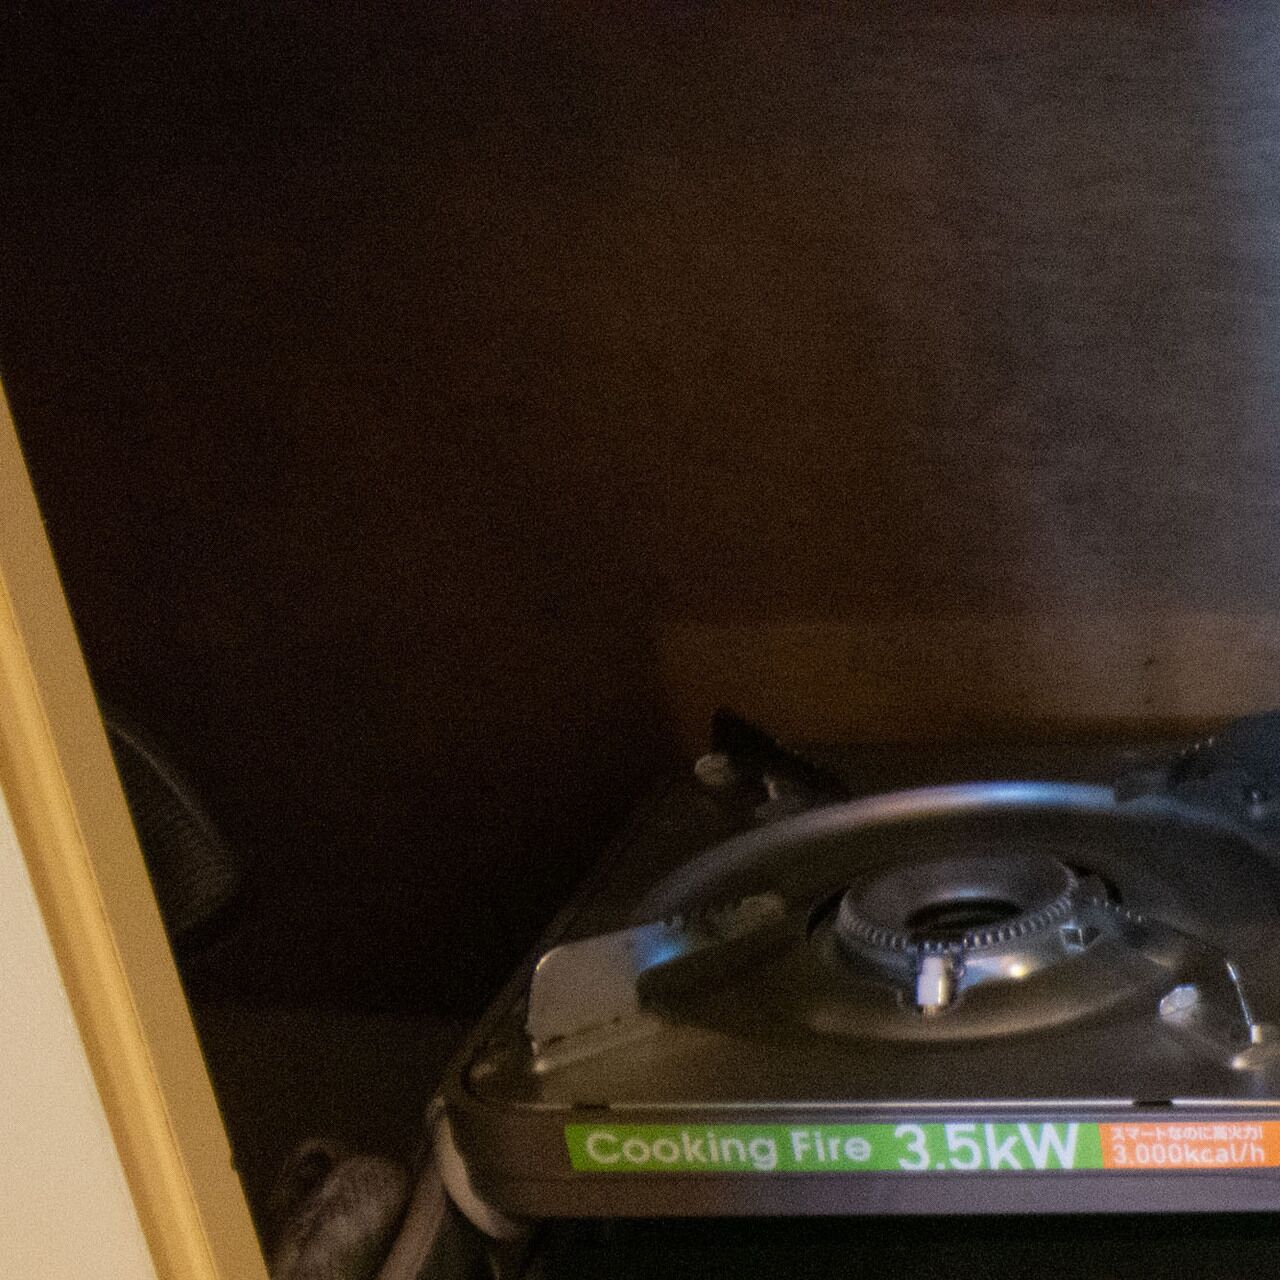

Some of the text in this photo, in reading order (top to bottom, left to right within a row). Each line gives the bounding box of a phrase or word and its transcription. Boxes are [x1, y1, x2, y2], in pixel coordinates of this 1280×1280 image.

[585, 1122, 1080, 1171] Cooking Fire 3.5kW
